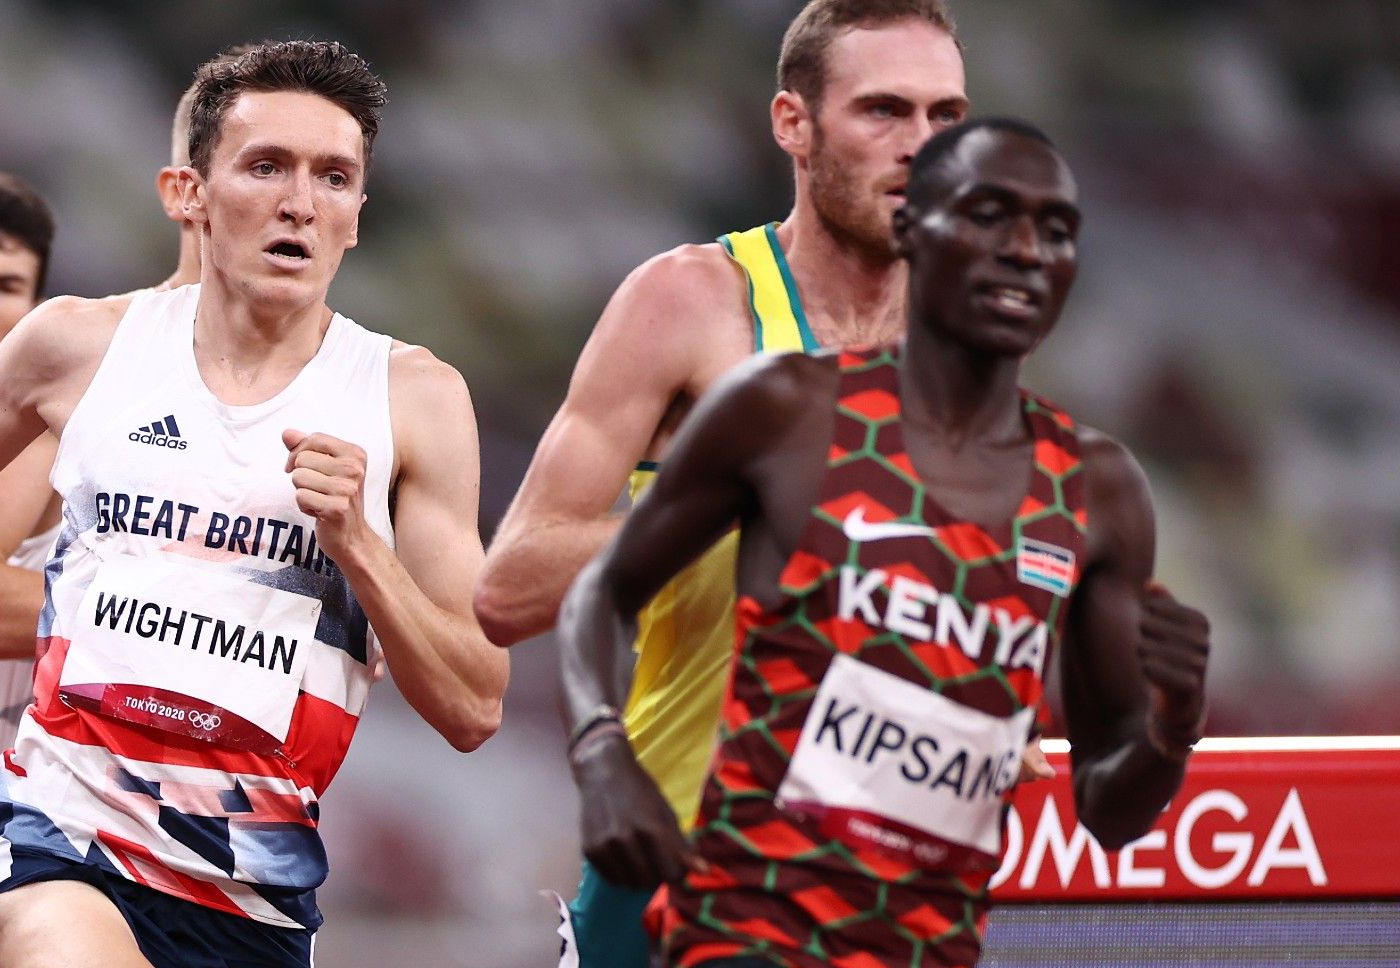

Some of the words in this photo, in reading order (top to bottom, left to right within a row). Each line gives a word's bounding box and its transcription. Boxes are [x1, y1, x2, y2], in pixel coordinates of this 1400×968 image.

[129, 432, 188, 450] adidas
[95, 492, 199, 542] GREAT
[95, 592, 298, 675] WIGHTMAN
[838, 565, 1048, 679] KENYA
[125, 696, 158, 713] TOKYO
[158, 705, 185, 721] 2020
